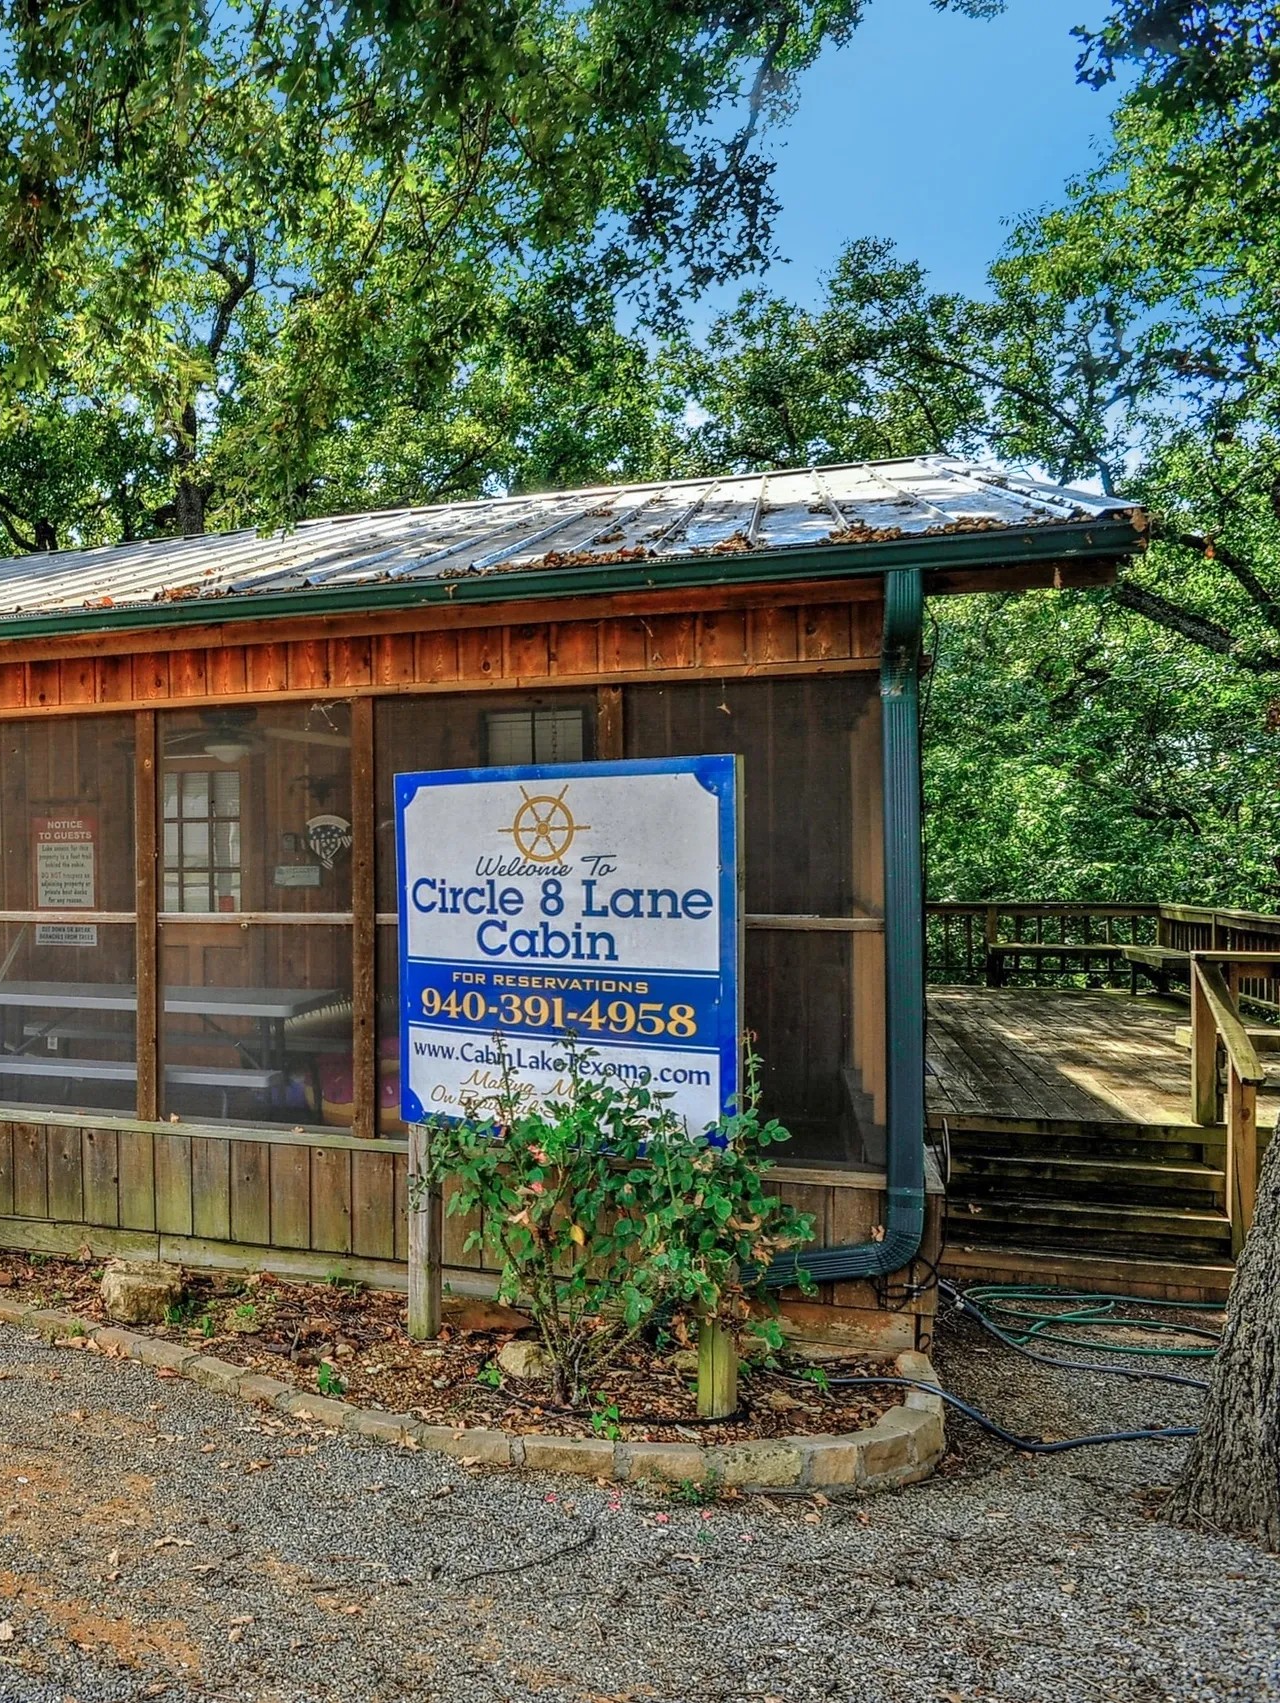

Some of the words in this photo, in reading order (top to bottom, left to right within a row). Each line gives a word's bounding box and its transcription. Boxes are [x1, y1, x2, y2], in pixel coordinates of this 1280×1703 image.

[38, 832, 51, 840] TO
[54, 831, 92, 840] GUESTS
[47, 820, 83, 829] NOTICE
[475, 855, 573, 877] Welcome
[581, 854, 617, 877] To
[412, 877, 524, 916] Circle
[540, 878, 564, 917] 8
[581, 879, 713, 919] Lane
[477, 919, 619, 961] Cabin
[452, 971, 486, 986] FOR
[493, 974, 649, 995] RESERVATIONS
[421, 987, 698, 1038] 940-391-4958
[431, 1085, 456, 1104] On
